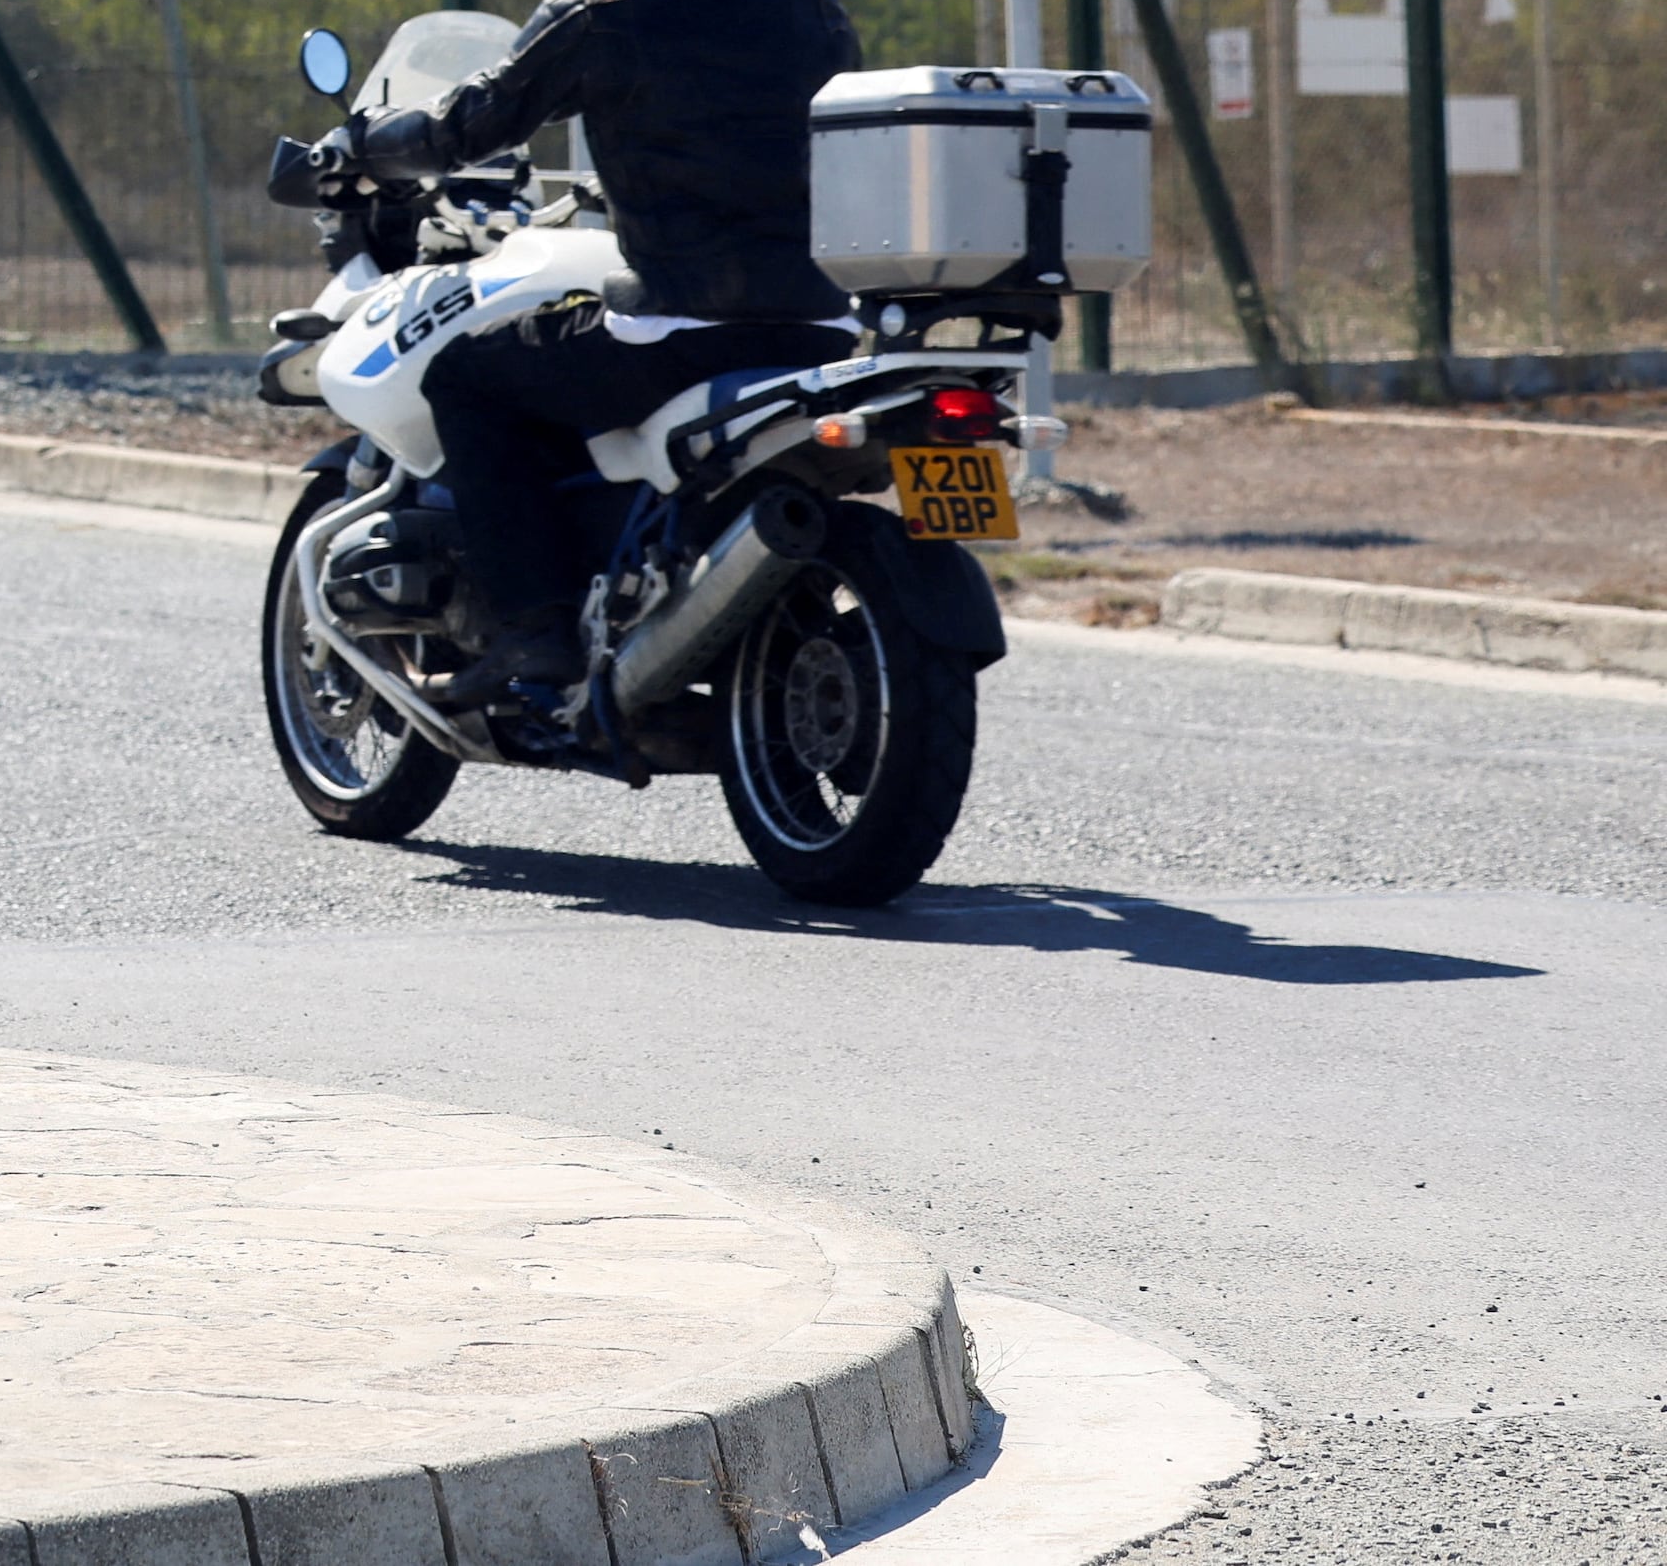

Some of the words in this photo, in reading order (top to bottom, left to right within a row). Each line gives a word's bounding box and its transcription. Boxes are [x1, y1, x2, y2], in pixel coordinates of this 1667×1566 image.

[394, 284, 476, 355] GS
[904, 455, 996, 493] X201
[921, 496, 998, 533] OBP
